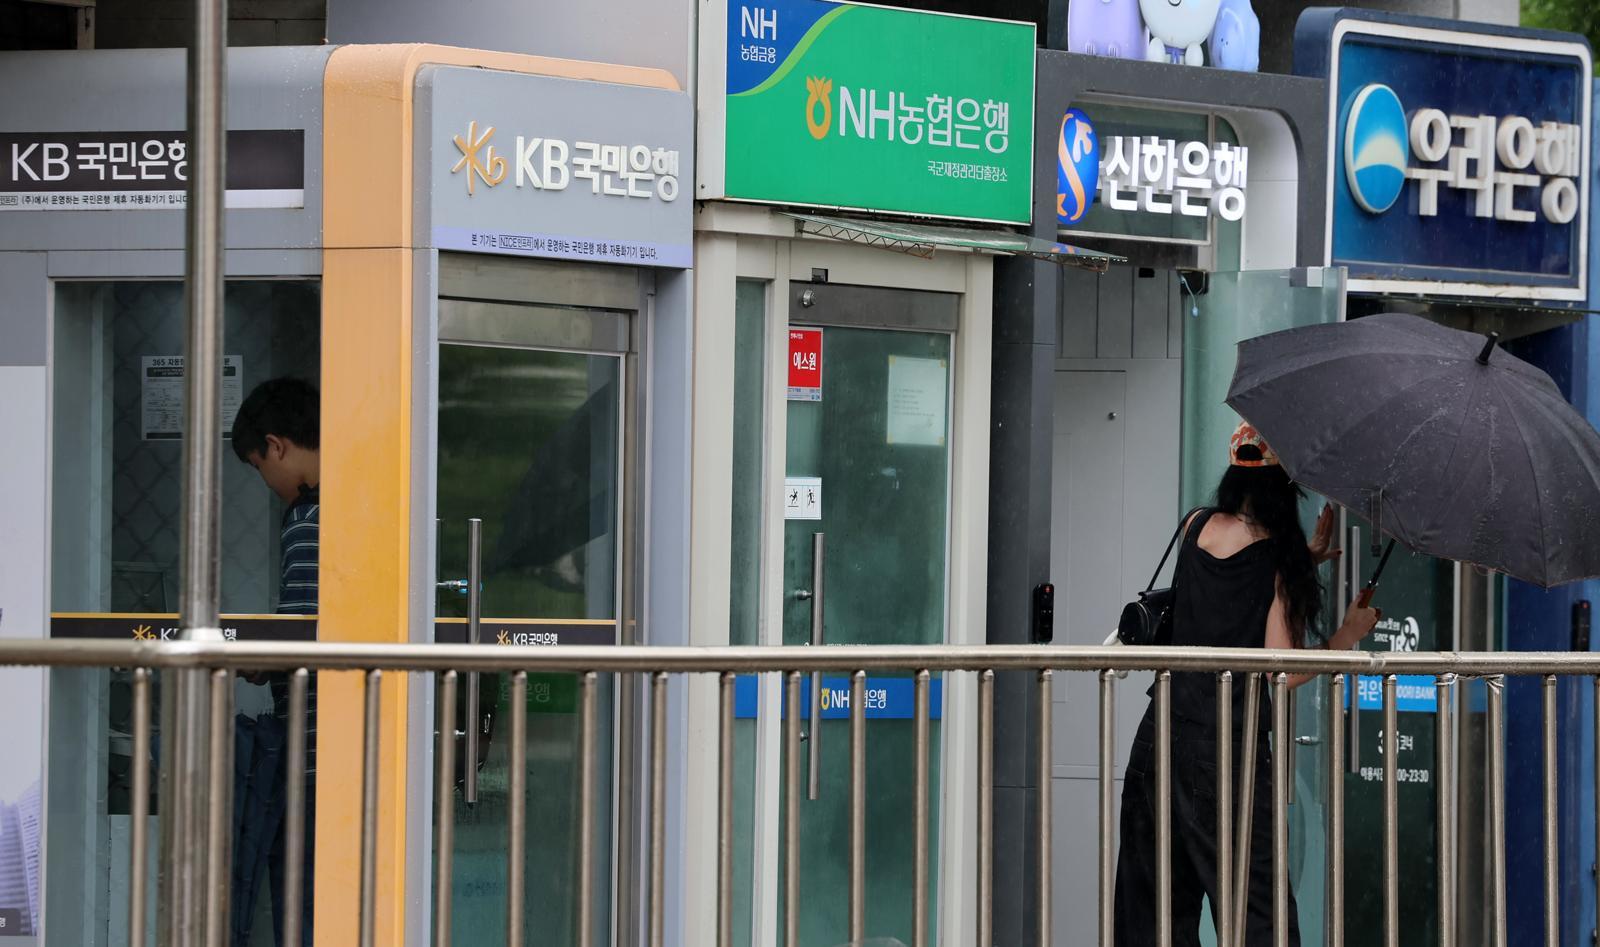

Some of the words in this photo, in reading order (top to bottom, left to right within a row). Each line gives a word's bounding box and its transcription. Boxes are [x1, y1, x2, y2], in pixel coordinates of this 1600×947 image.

[741, 6, 777, 41] NH
[741, 44, 776, 64] 농협금융
[839, 86, 1009, 154] NH농협은행
[515, 135, 679, 202] KB국민은행
[1104, 135, 1249, 221] 신한은행
[1407, 107, 1580, 224] 우리은행
[52, 195, 79, 205] 운영하는
[83, 195, 111, 205] 국민은행
[130, 195, 165, 205] 자동화기기
[480, 234, 497, 248] 기기는
[547, 239, 569, 252] 운영하는
[572, 241, 594, 255] 국민은행
[610, 245, 637, 258] 자동화기기
[793, 351, 816, 371] 에스원
[831, 689, 887, 709] NH은행
